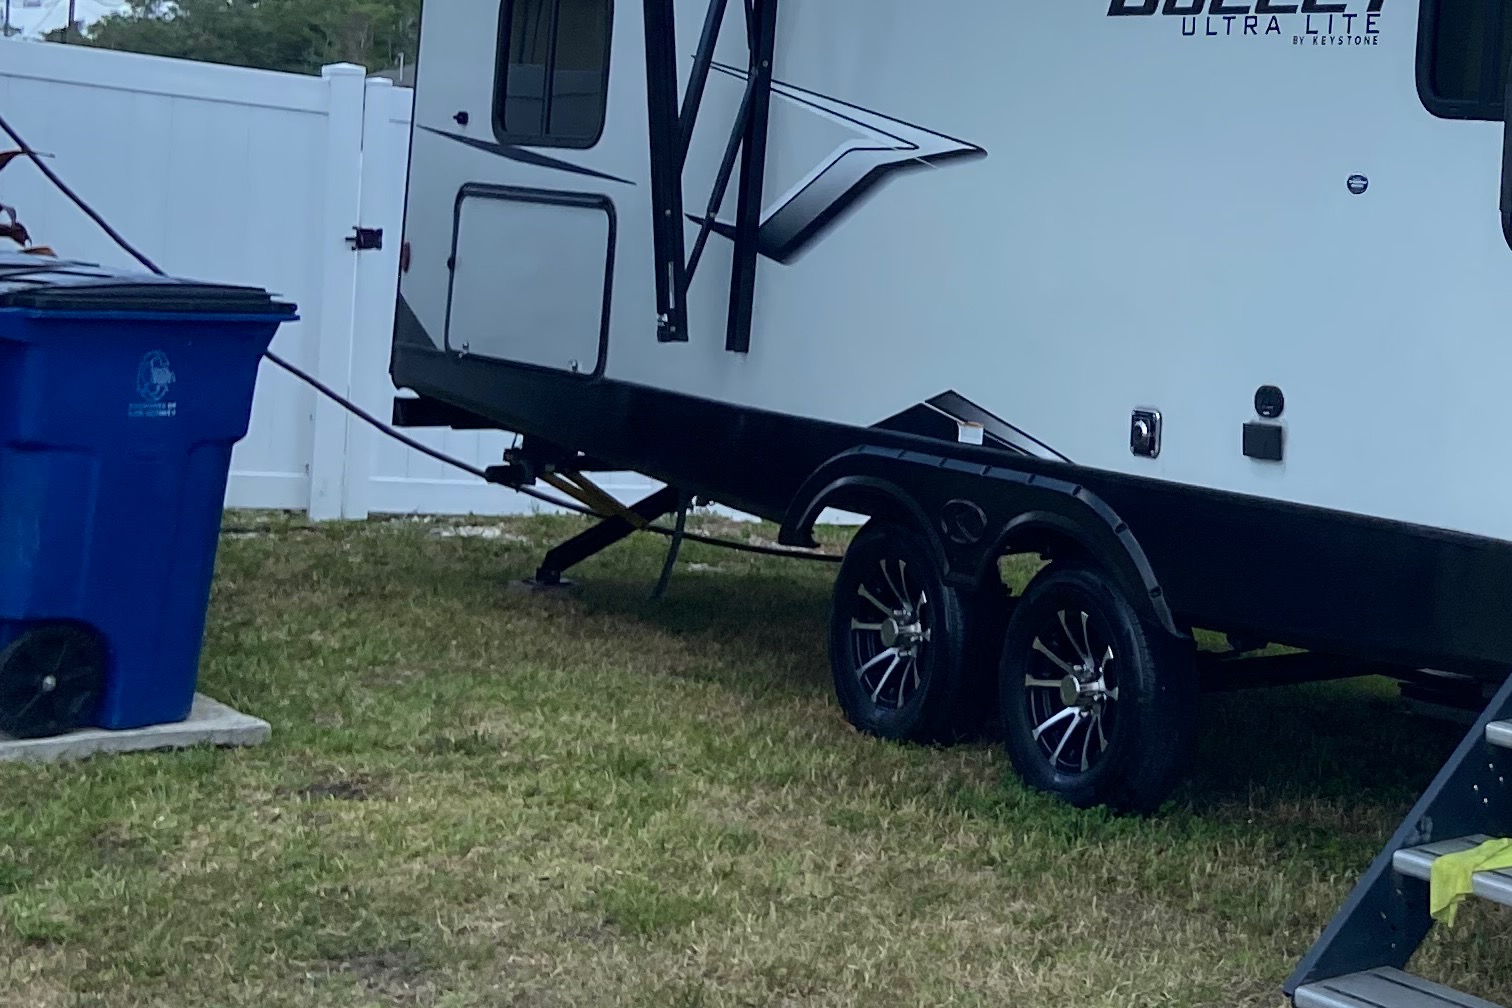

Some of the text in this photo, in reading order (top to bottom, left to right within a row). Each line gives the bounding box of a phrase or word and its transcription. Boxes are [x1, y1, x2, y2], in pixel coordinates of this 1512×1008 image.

[1182, 13, 1381, 36] ULTRA LITE
[1292, 35, 1379, 46] BY KEYSTONE
